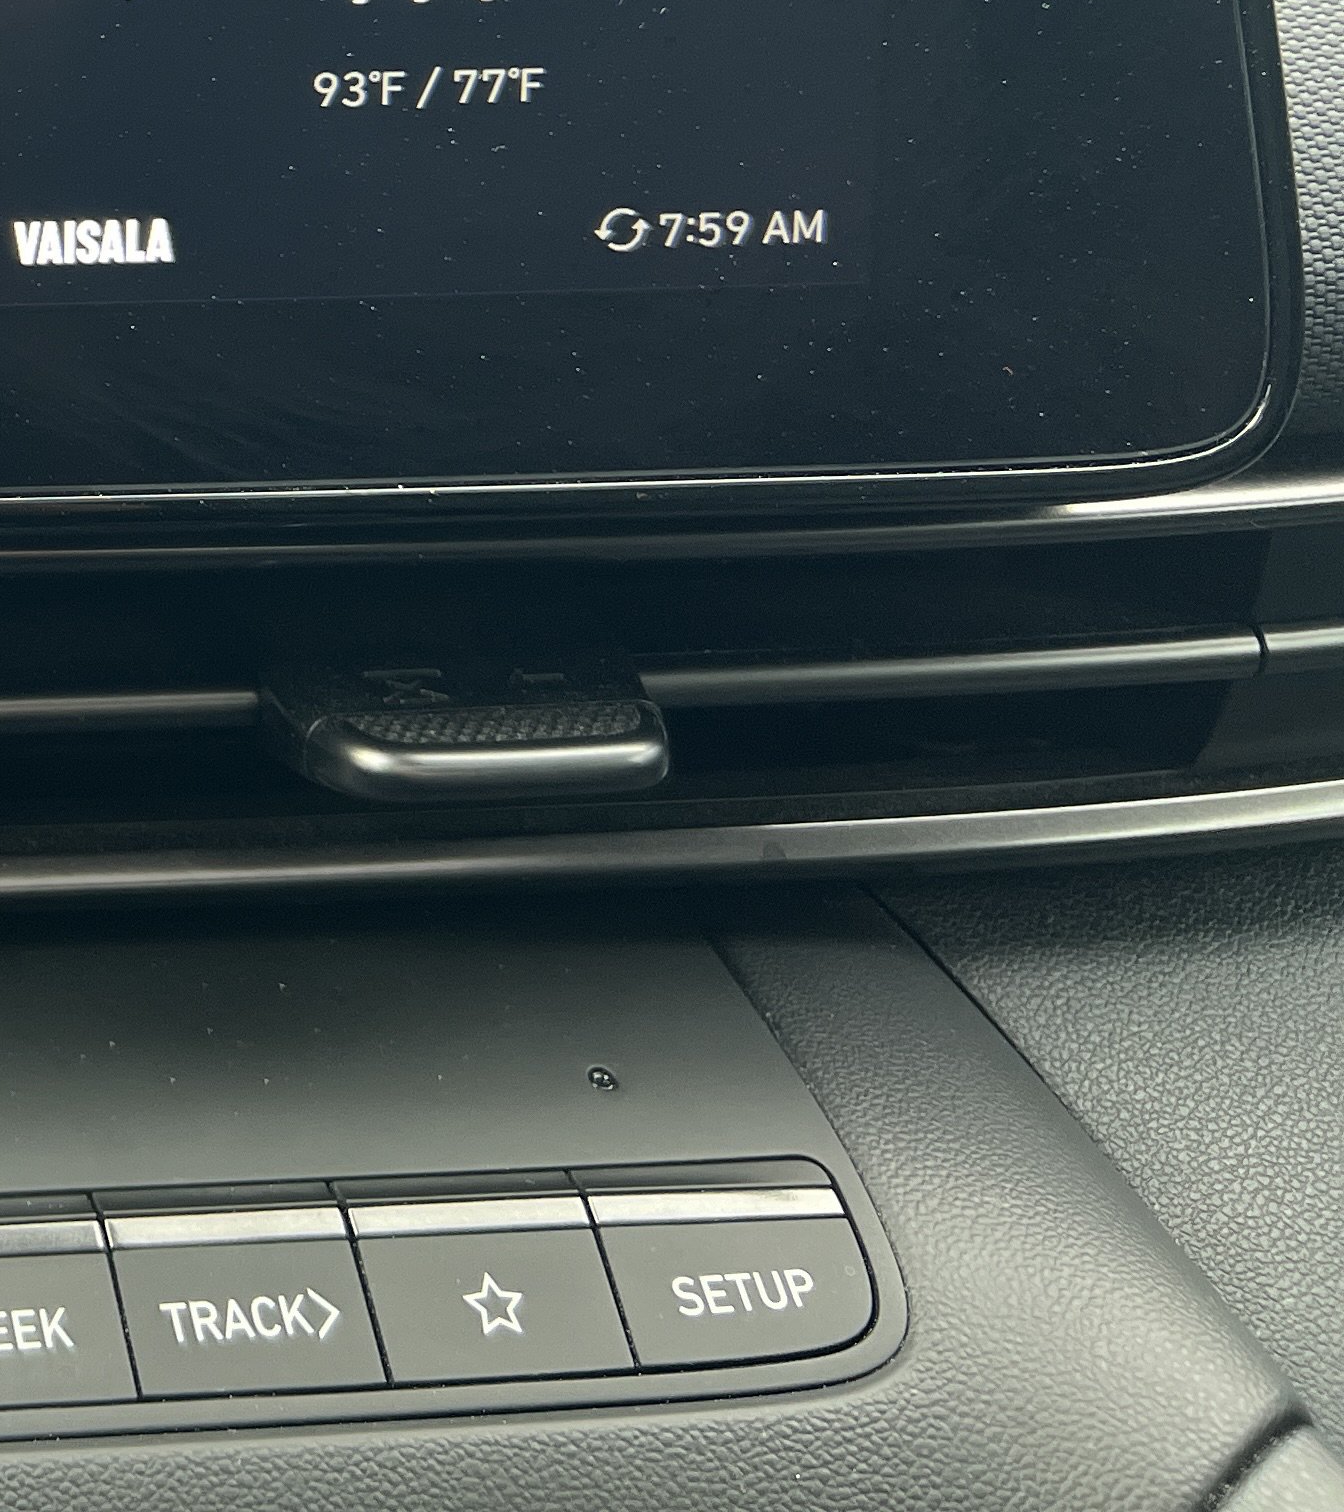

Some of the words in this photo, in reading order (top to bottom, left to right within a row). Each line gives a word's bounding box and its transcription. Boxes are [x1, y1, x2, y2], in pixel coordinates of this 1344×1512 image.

[313, 70, 406, 109] 93°F
[452, 67, 546, 106] 77°F
[14, 219, 174, 267] VAISALA
[658, 212, 752, 248] 7:59
[763, 209, 827, 245] AM
[672, 1268, 816, 1319] SETUP
[160, 1292, 313, 1345] TRACK
